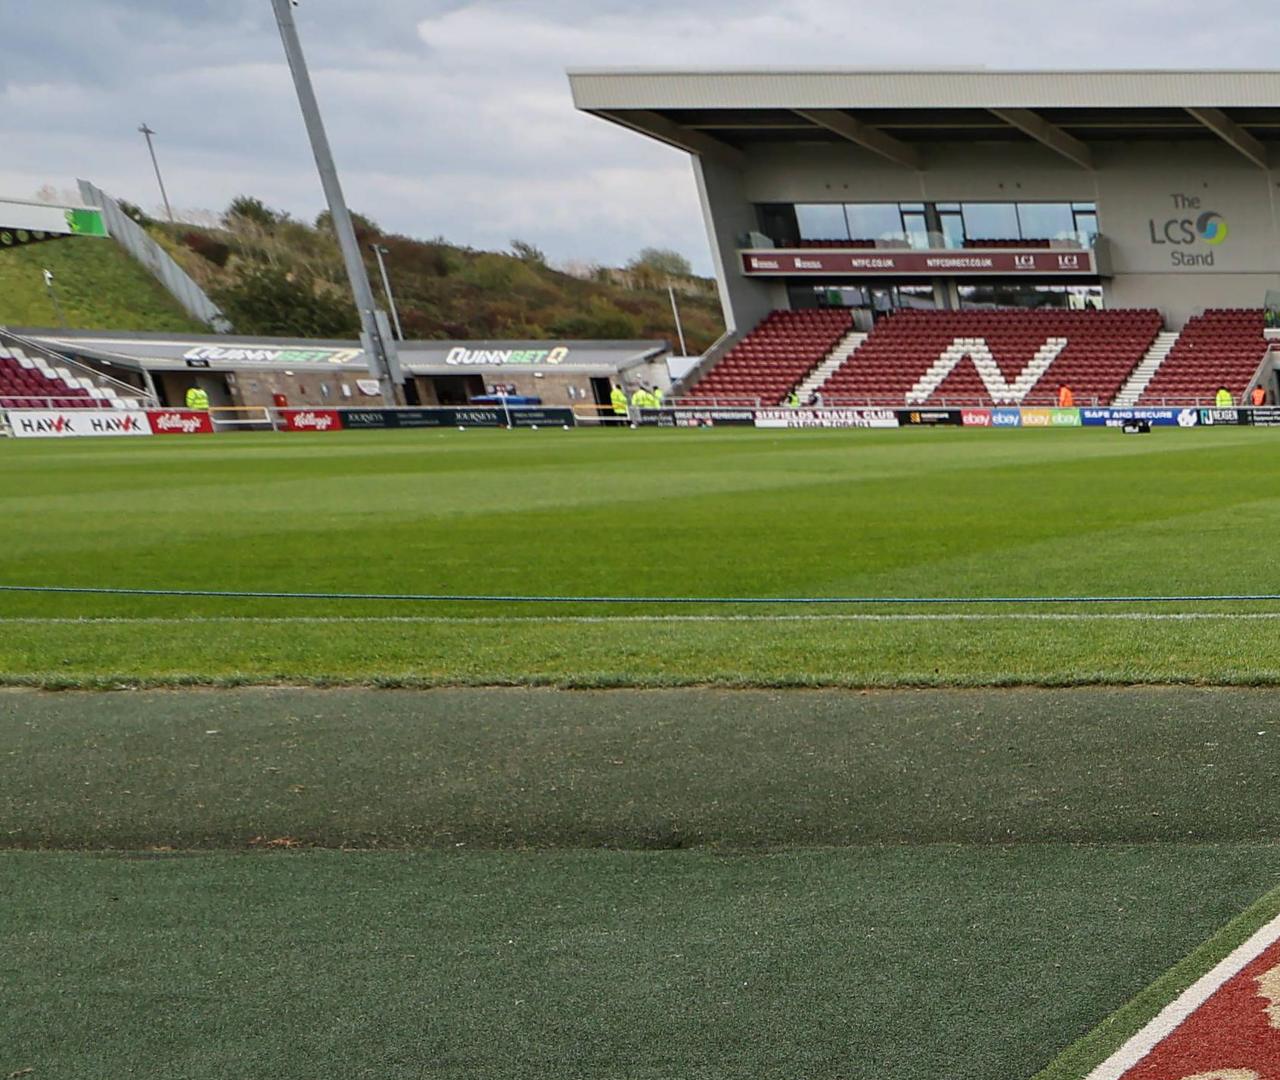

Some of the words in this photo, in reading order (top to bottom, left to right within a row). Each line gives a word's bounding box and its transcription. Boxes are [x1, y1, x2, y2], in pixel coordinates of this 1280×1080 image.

[1170, 194, 1200, 209] The
[1149, 219, 1195, 245] LCS
[1171, 251, 1214, 266] Stand
[446, 347, 547, 364] QUINNBET
[292, 412, 332, 431] Kellogg's
[755, 411, 814, 419] SIXFIELDS
[816, 411, 858, 419] TRAVEL
[862, 411, 895, 419] CLUB
[963, 412, 990, 427] ebay
[992, 412, 1020, 426] ebay
[1022, 411, 1049, 426] ebay
[1052, 411, 1080, 426] ebay
[1212, 409, 1239, 420] NEXGEN
[20, 415, 75, 432] HAWK
[90, 415, 142, 432] HAWK
[156, 413, 201, 432] Kellogg's
